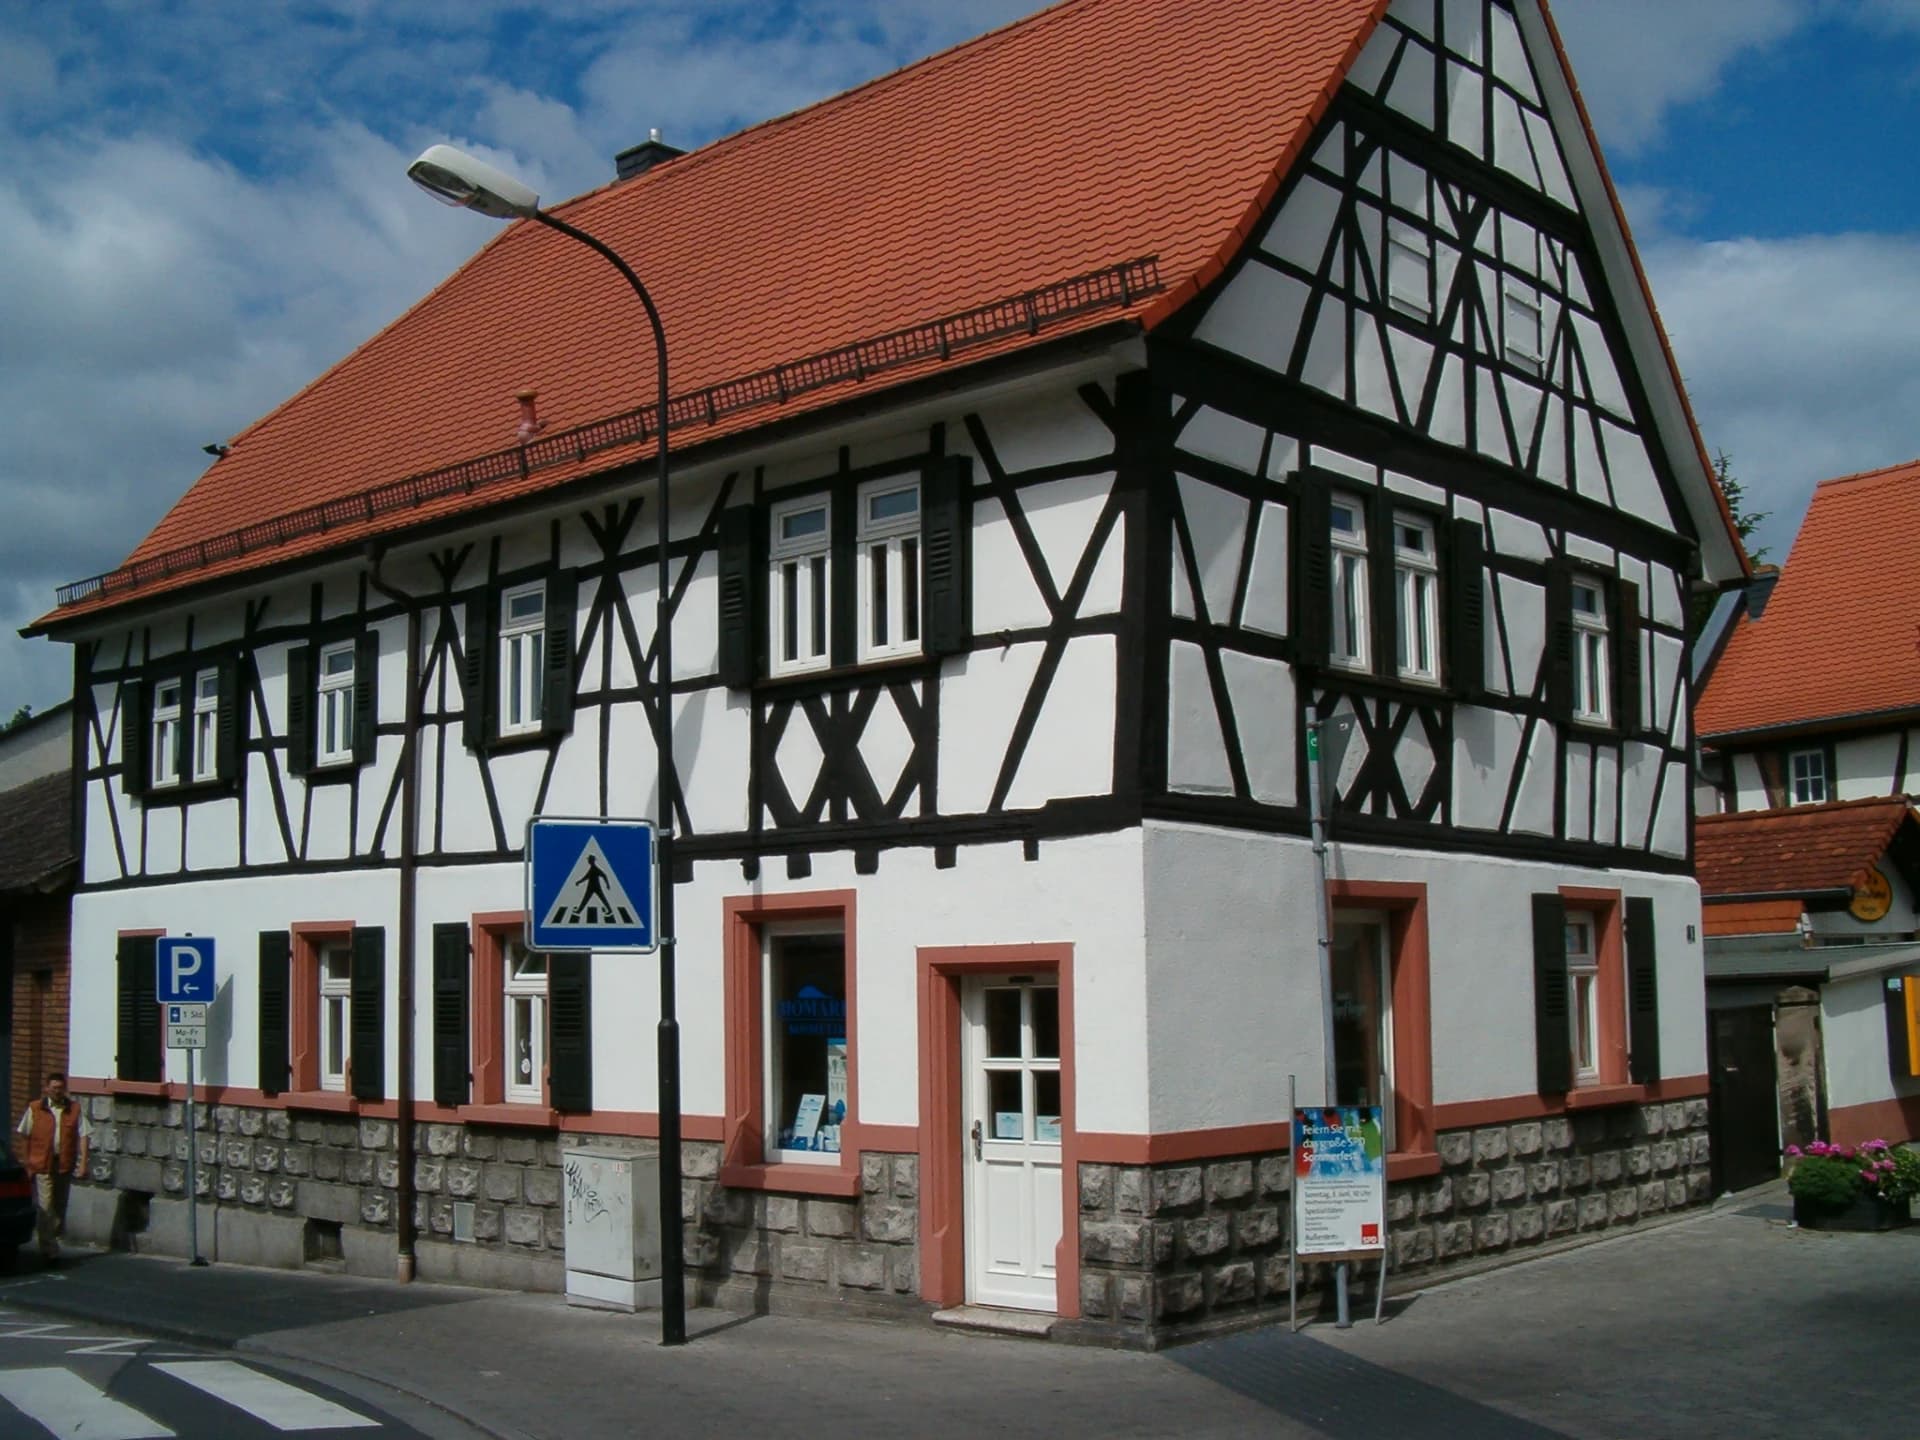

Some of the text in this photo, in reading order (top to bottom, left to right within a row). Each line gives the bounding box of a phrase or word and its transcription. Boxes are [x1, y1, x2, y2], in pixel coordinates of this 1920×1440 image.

[171, 946, 202, 994] P
[1302, 1125, 1329, 1135] Feiern
[1330, 1123, 1344, 1134] Sie
[1349, 1136, 1366, 1147] SPD
[1362, 1236, 1377, 1244] SPD
